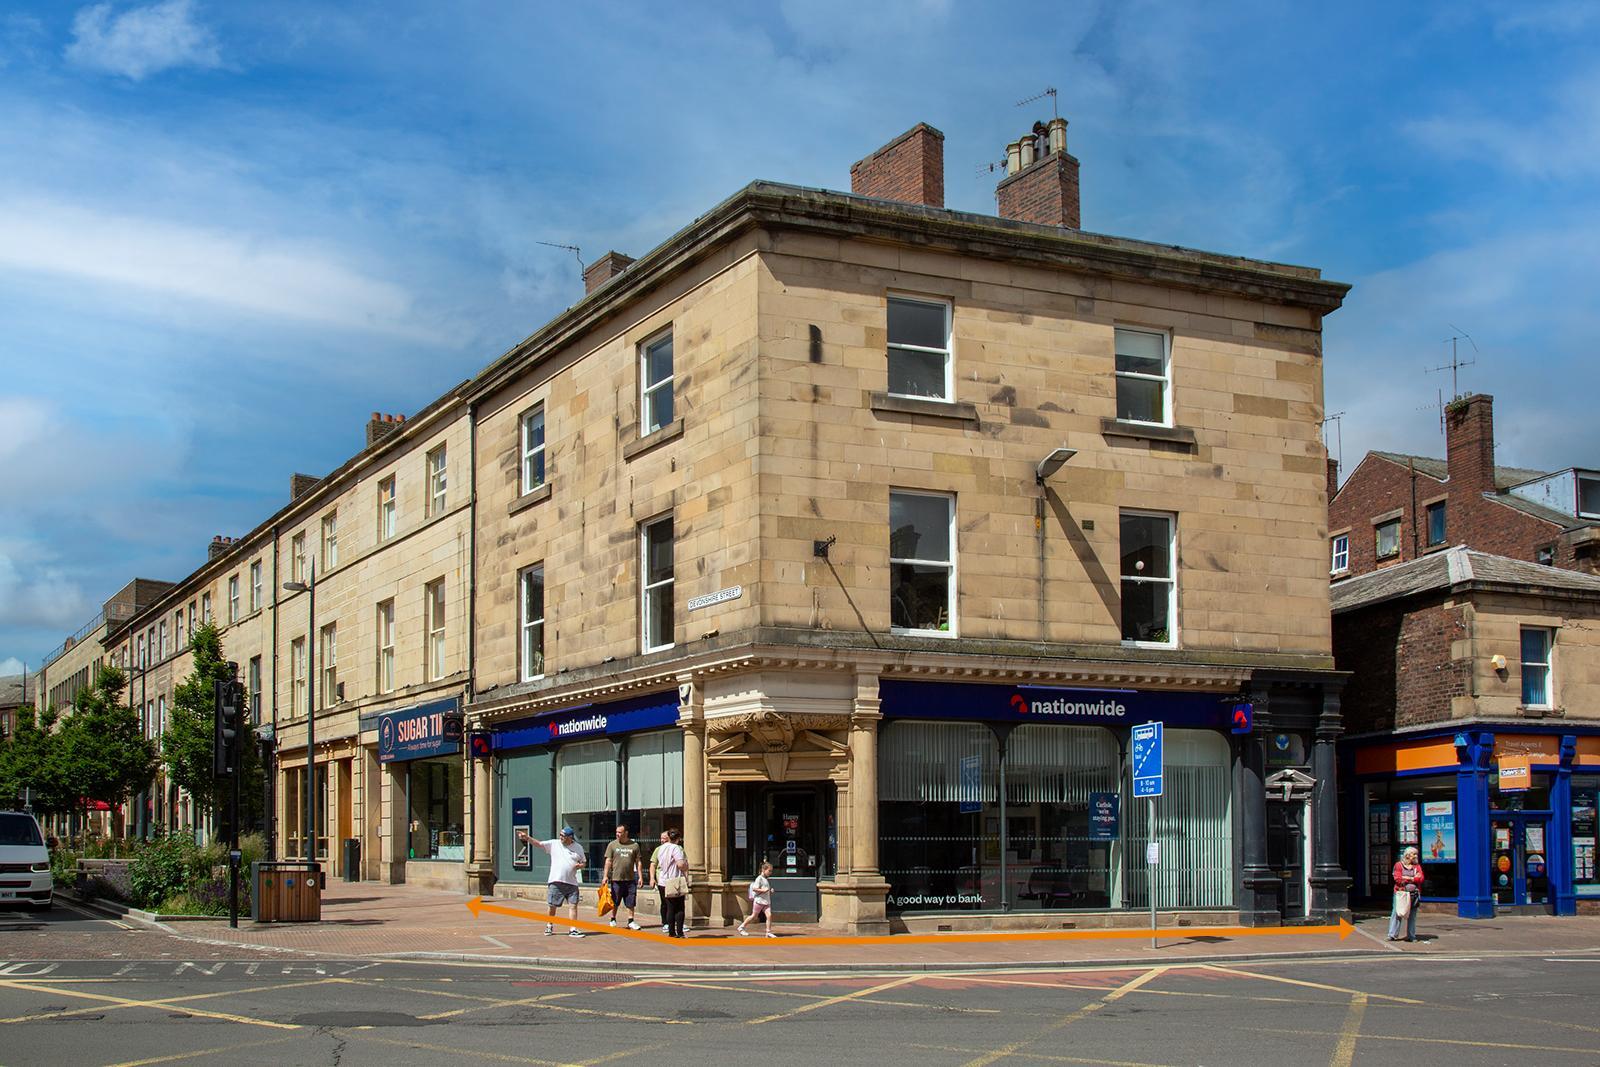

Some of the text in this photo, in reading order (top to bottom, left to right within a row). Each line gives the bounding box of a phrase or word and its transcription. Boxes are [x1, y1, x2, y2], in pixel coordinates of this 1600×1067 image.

[689, 588, 738, 608] DEVONSHIRE STREET
[1031, 698, 1125, 716] nationwide
[398, 716, 428, 742] SUGAR
[559, 714, 607, 734] nationwide
[1521, 741, 1538, 749] Agents
[886, 893, 986, 906] A good way to bank.
